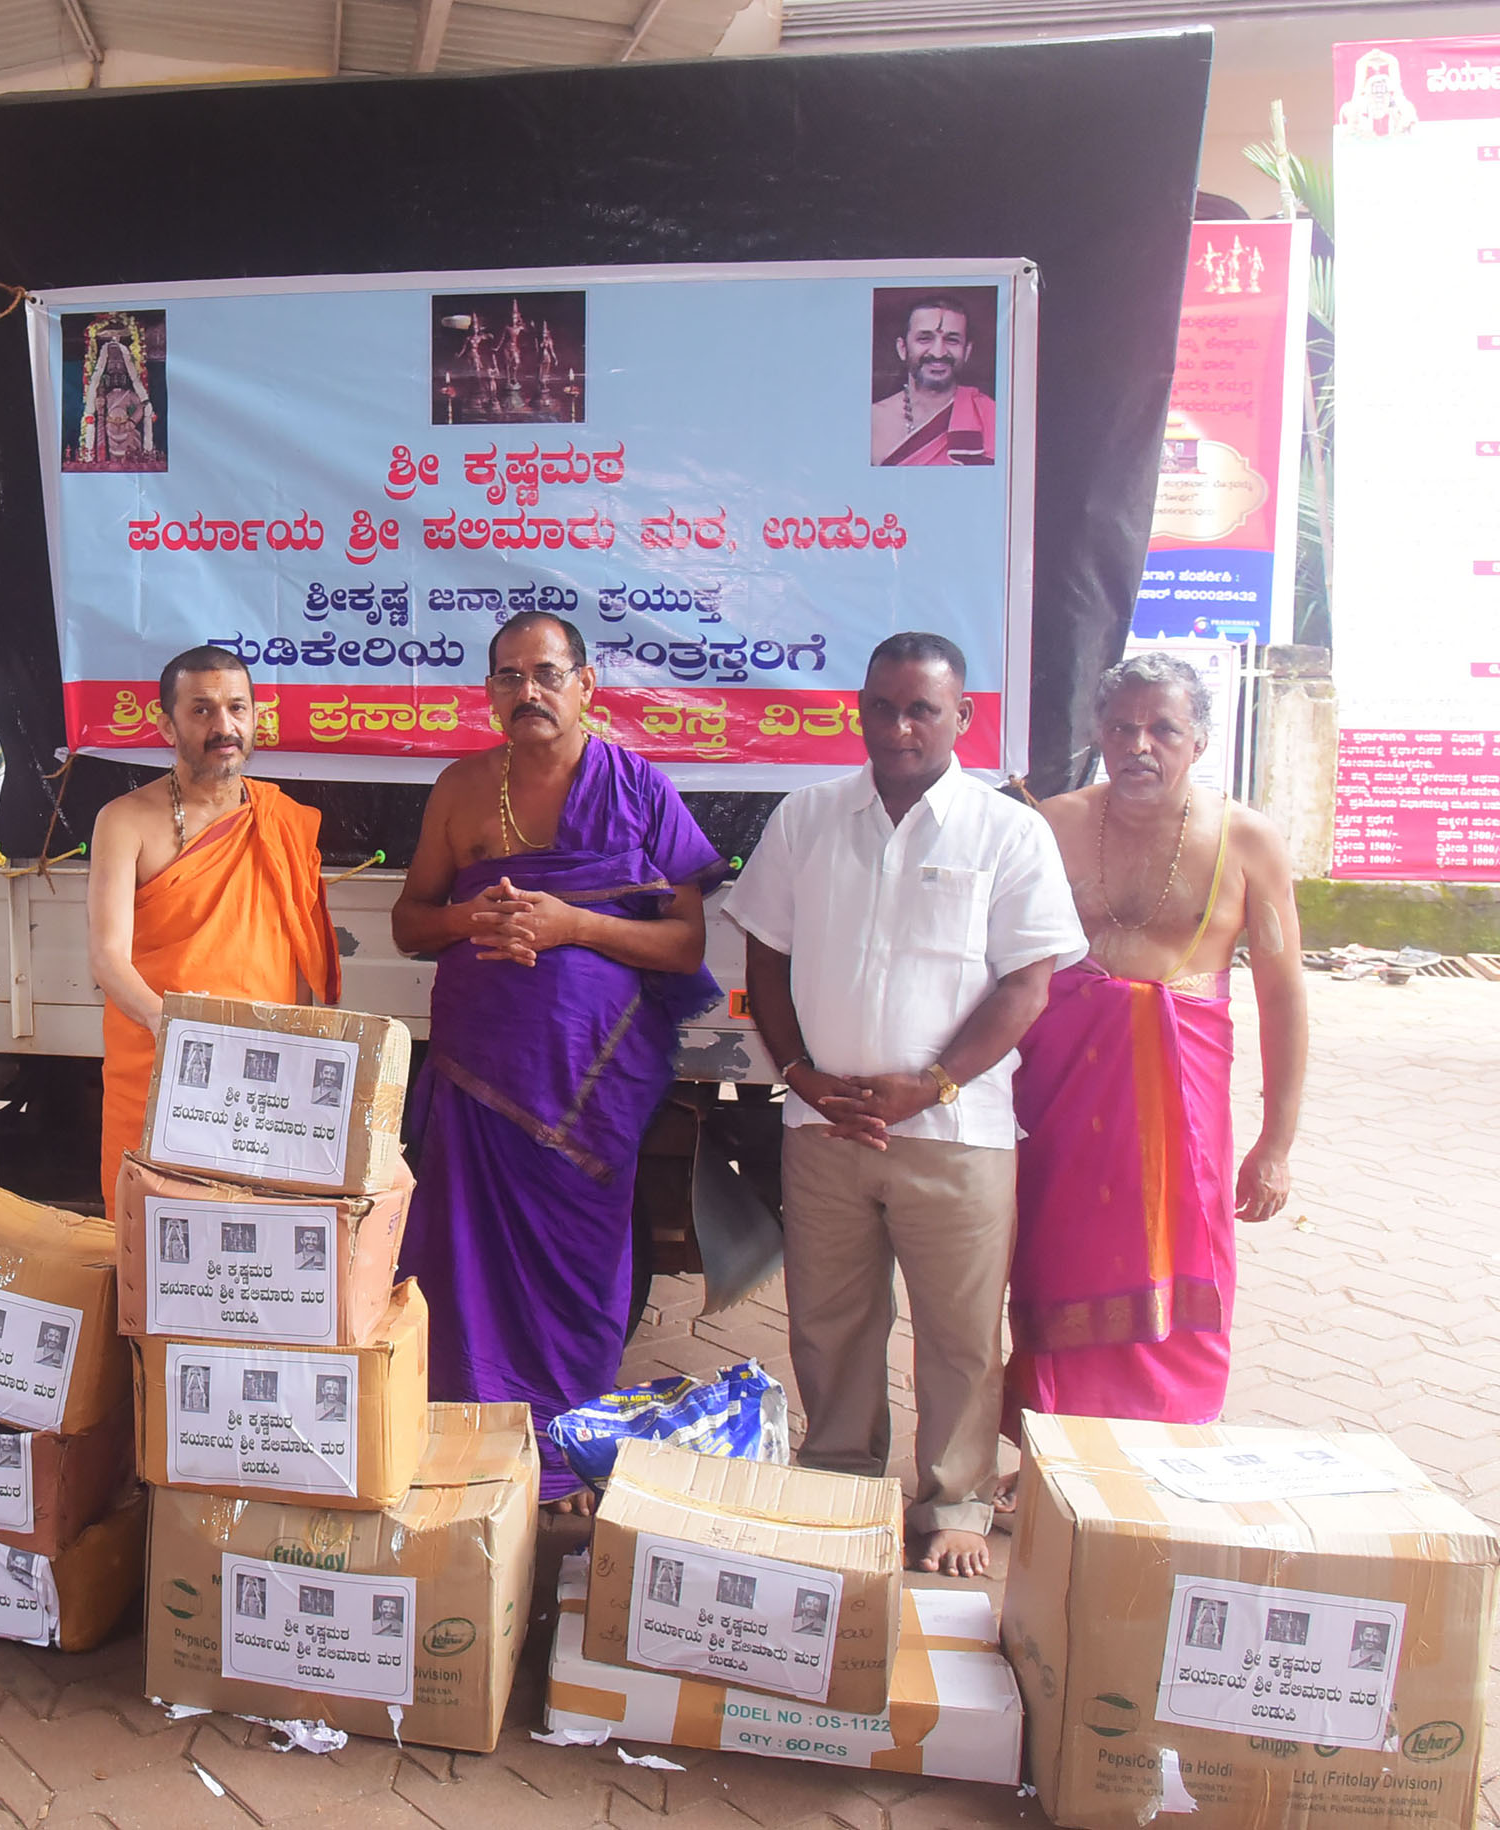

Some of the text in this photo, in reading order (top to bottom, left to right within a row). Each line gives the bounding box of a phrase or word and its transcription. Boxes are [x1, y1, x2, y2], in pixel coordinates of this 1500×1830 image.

[384, 441, 625, 507] ಶ್ರೀ ಕೃಷ್ಣಮಠ
[128, 505, 907, 566] ಪರ್ಯಾಯ ಶ್ರೀ ಪಲಿಮಾರು ಮಠ, ಉಡುಪಿ
[303, 581, 409, 626] ಶ್ರೀಕೃಷ್ಣ
[599, 581, 722, 623] ಪ್ರಯುಕ್ತ
[208, 630, 827, 682] ಮಡಿಕೇರಿಯ ಸಂತ್ರಸ್ತರಿಗೆ
[309, 694, 459, 742] ಪ್ರಸಾದ
[644, 698, 729, 759] ವಸ್ತ್ರ
[224, 1087, 290, 1114] ಶ್ರೀ ಕೃಷ್ಣಮಠ
[172, 1104, 336, 1140] ಪರ್ಯಾಯ ಶ್ರೀ ಪಲಿಮಾರು ಮಠ
[232, 1138, 269, 1155] ಉಡುಪಿ
[34, 1383, 57, 1399] ಮಠ
[284, 1618, 350, 1644] ಶ್ರೀ ಕೃಷ್ಣಮಠ
[697, 1608, 767, 1636] ಶ್ರೀ ಕೃಷ್ಣಮಠ
[174, 1628, 218, 1650] PepsiCo
[235, 1632, 402, 1667] ಪರ್ಯಾಯ ಶ್ರೀ ಪಲಿಮಾರು ಮಠ
[644, 1618, 820, 1667] ಪರ್ಯಾಯ ಶ್ರೀ ಪಲಿಮಾರು ಮಠ
[297, 1663, 335, 1679] ಉಡುಪಿ
[709, 1654, 748, 1672] ಉಡುಪಿ
[1242, 1649, 1322, 1678] ಶ್ರೀ ಕೃಷ್ಣಮಠ
[1179, 1666, 1378, 1706] ಪರ್ಯಾಯ ಶ್ರೀ ಪಲಿಮಾರು ಮಠ
[778, 1710, 802, 1724] NO
[1252, 1704, 1296, 1721] ಉಡುಪಿ
[739, 1732, 771, 1747] QTY
[814, 1743, 847, 1756] PCS
[1411, 1731, 1453, 1754] Lehar
[1098, 1749, 1156, 1770] PepsiCo
[1293, 1771, 1443, 1793] Ltd. (Fritolay Division)
